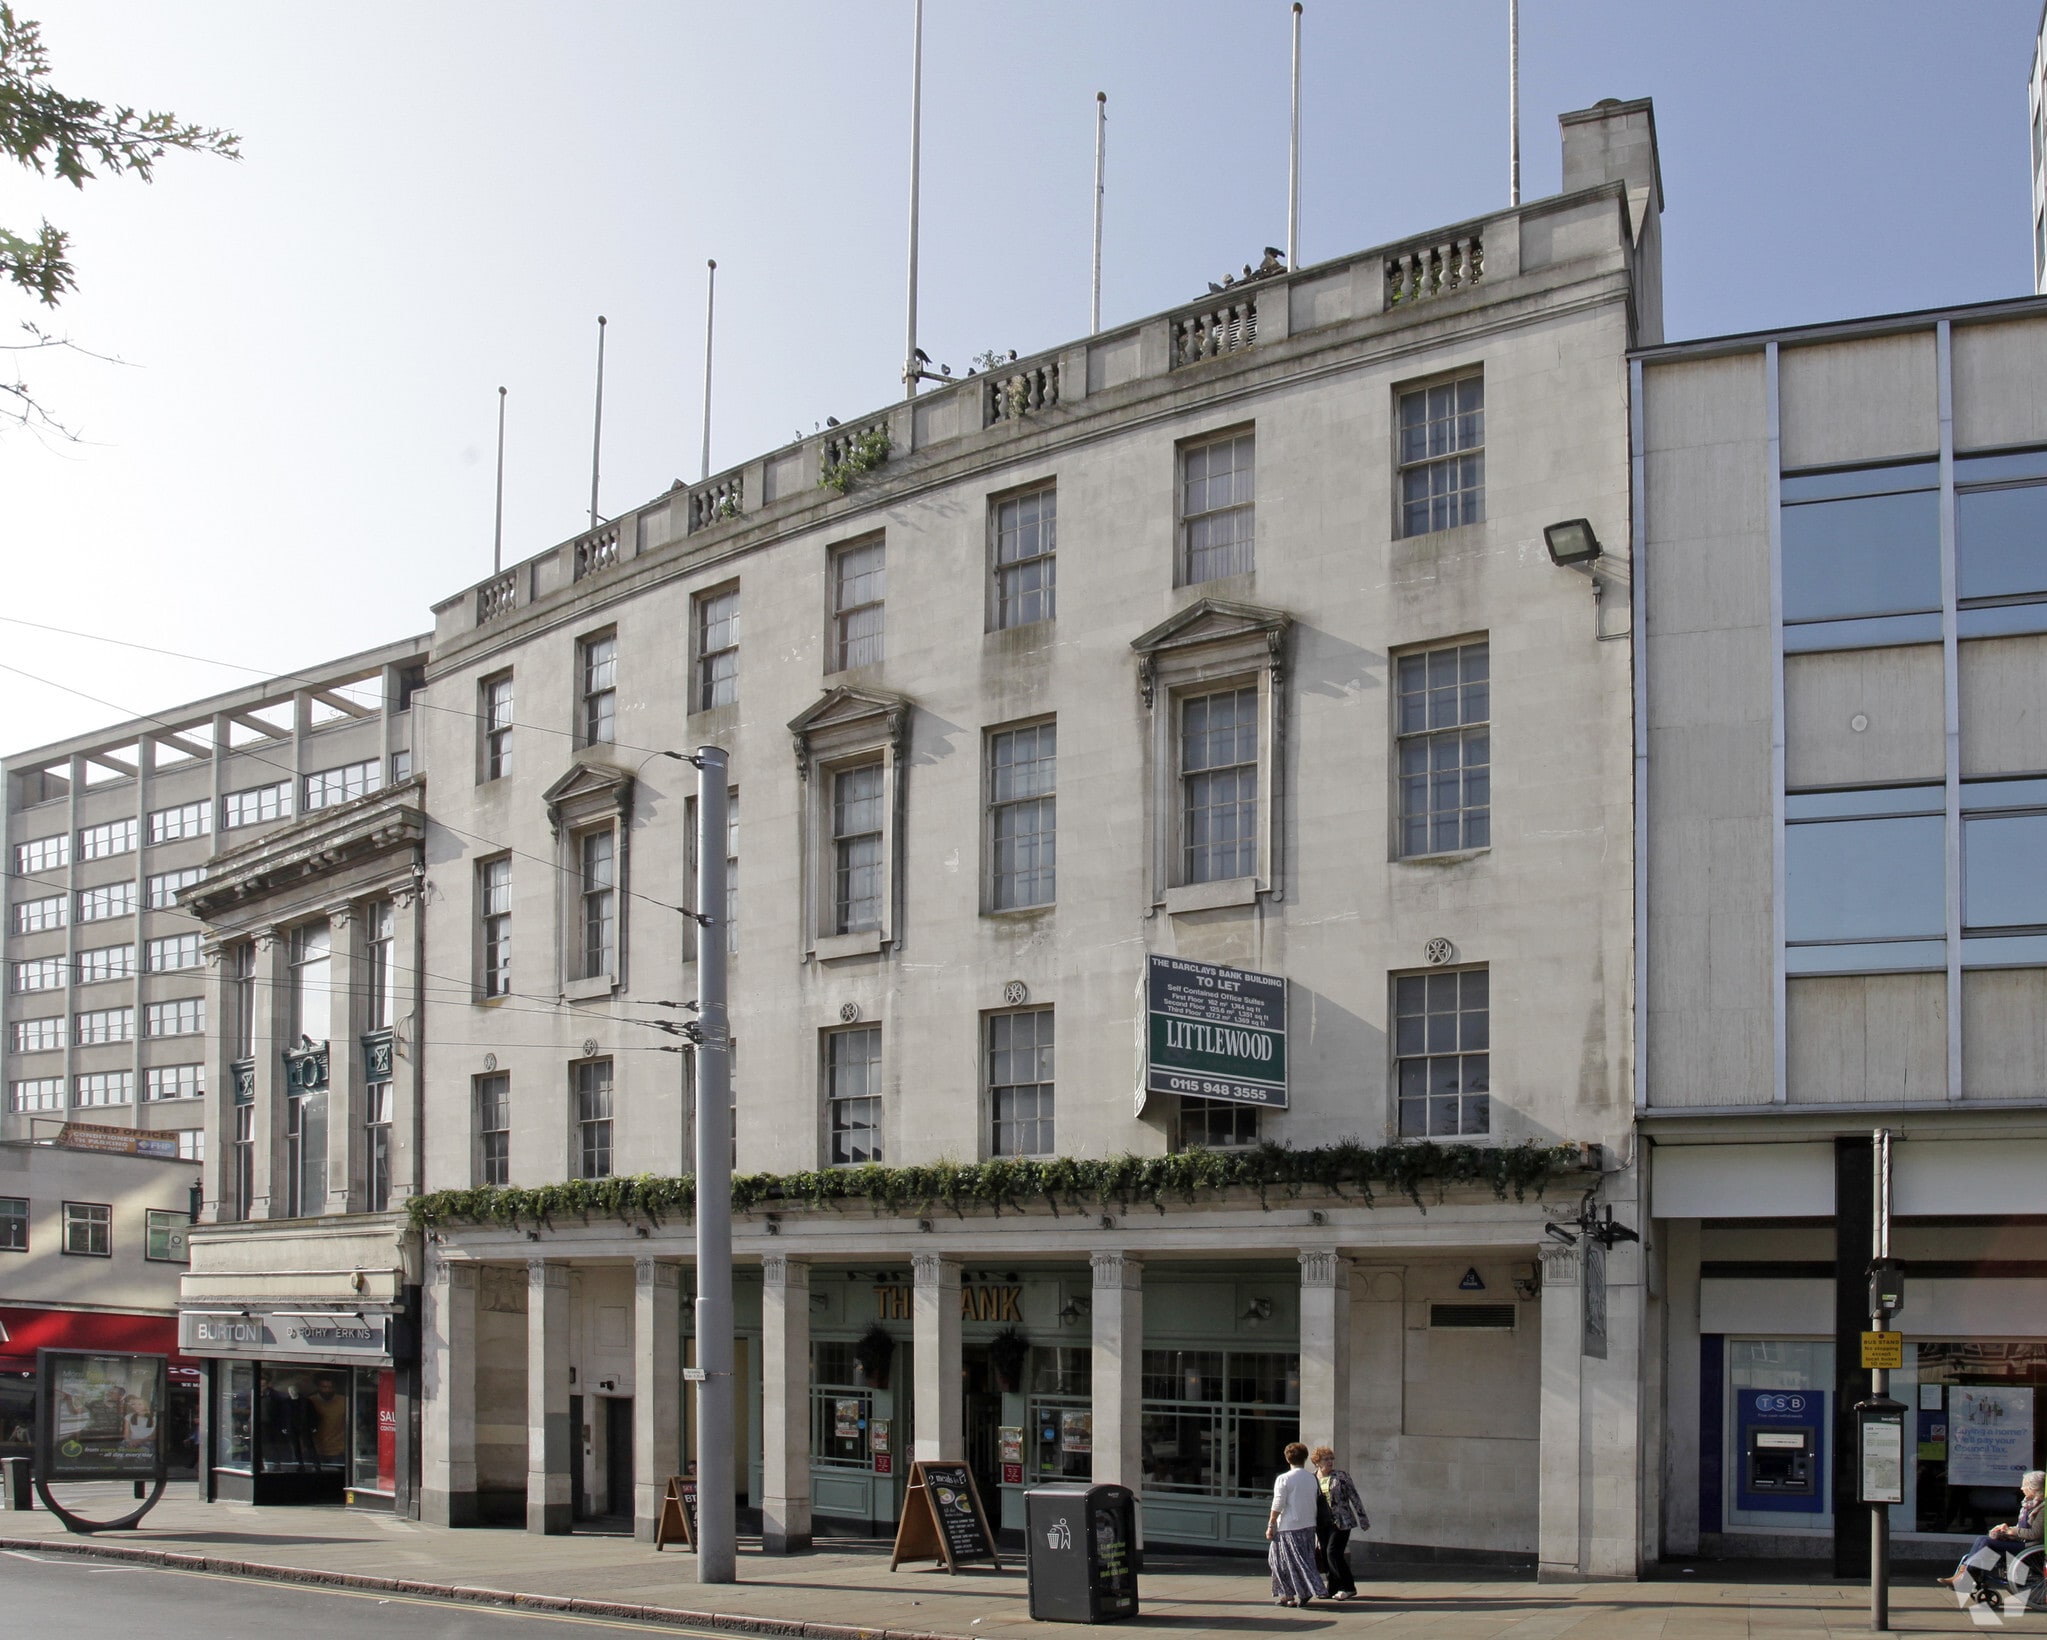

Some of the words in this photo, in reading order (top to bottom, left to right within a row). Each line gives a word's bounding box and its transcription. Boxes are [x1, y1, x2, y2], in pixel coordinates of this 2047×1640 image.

[1152, 958, 1169, 968] THE
[1172, 961, 1216, 976] BARCLAYS
[1219, 969, 1242, 980] BANK
[1245, 974, 1282, 987] BUILDING
[1196, 976, 1213, 987] TO
[1217, 981, 1240, 992] LET
[1167, 984, 1181, 993] Self
[1183, 987, 1219, 998] Contained
[1220, 993, 1242, 1003] Office
[1172, 993, 1186, 1001] First
[1187, 995, 1204, 1004] Floor
[1164, 998, 1188, 1008] Second
[1189, 1002, 1206, 1011] Floor
[1167, 1006, 1184, 1014] Third
[1185, 1008, 1202, 1016] Floor
[1166, 1020, 1273, 1061] LITTLEWOOD
[1170, 1077, 1200, 1092] 0115
[1203, 1082, 1230, 1095] 948
[1233, 1086, 1267, 1100] 3555
[73, 1131, 136, 1143] CONDITIONED
[124, 1127, 176, 1140] OFFICES
[150, 1142, 172, 1151] FHP
[873, 1286, 910, 1320] TH
[961, 1286, 1023, 1322] ANK
[198, 1323, 257, 1341] BURTON
[380, 1410, 396, 1422] SAL
